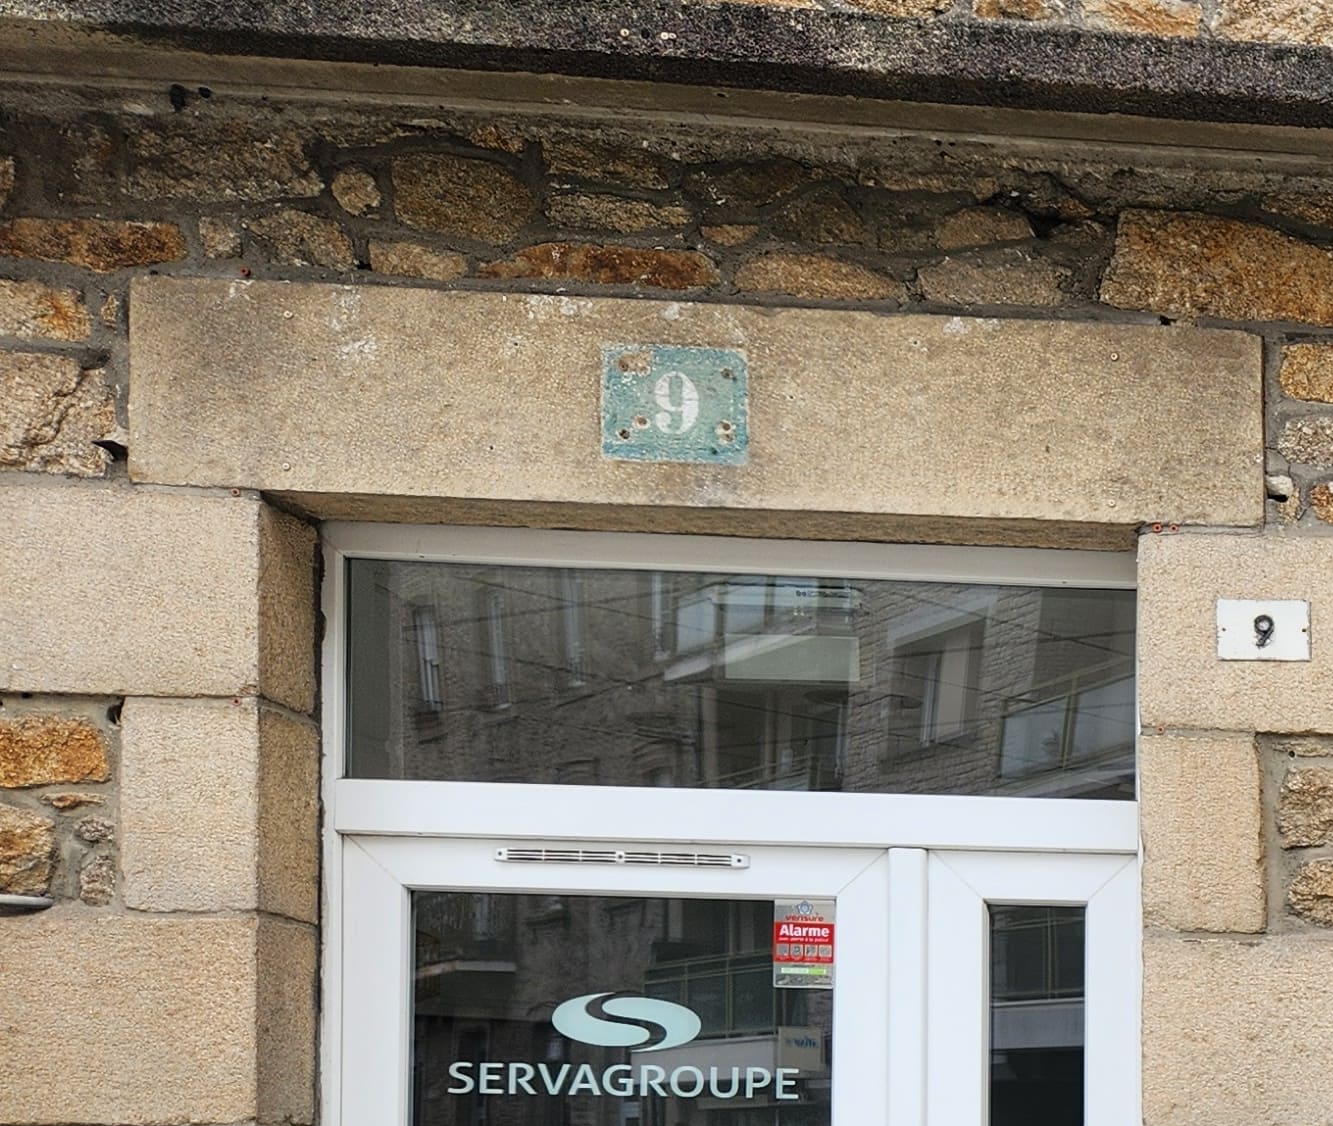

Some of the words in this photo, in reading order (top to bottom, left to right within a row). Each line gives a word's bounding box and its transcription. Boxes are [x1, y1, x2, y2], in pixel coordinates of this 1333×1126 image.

[653, 370, 699, 434] 9
[1253, 615, 1274, 648] 9
[779, 924, 830, 937] Alarme
[448, 1061, 800, 1100] SERVAGROUPE
